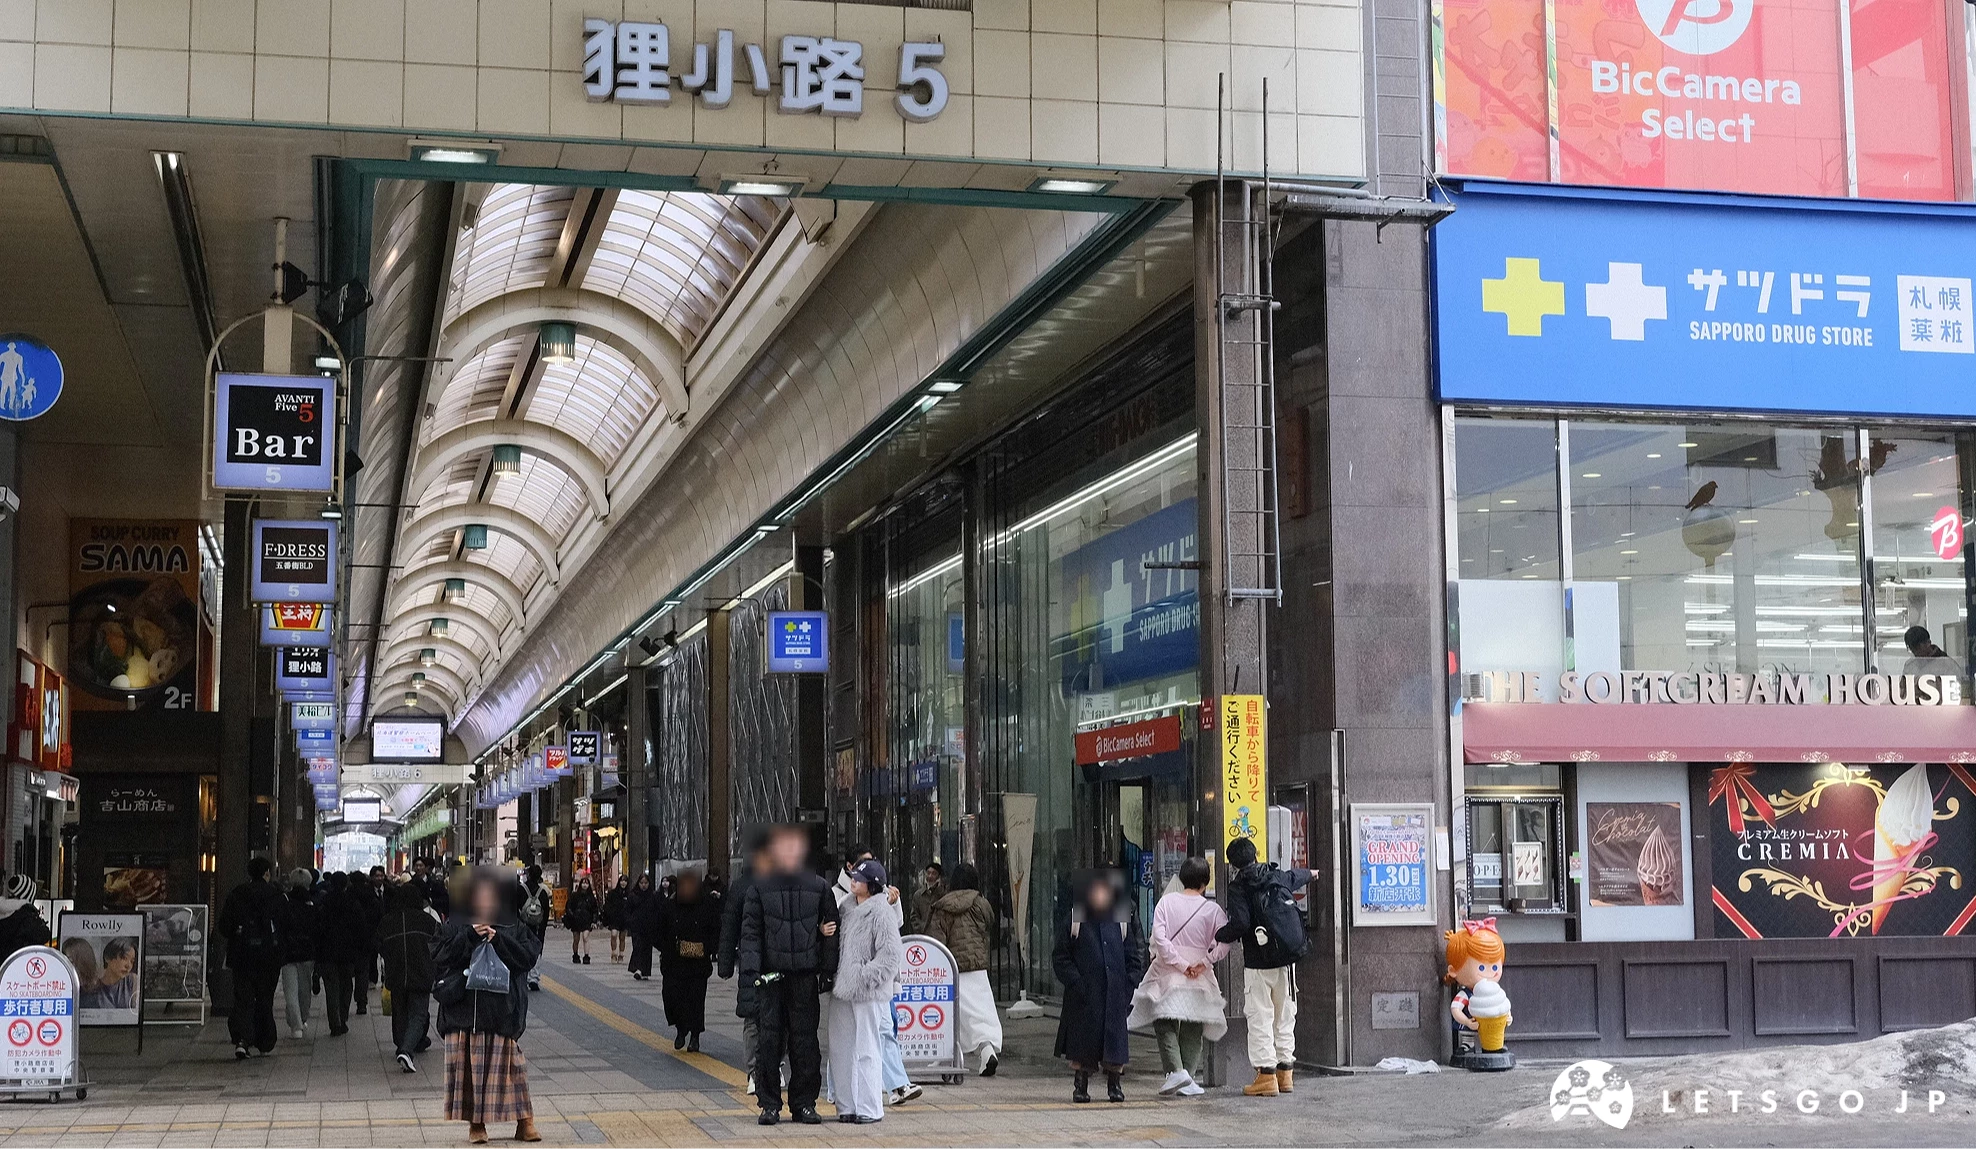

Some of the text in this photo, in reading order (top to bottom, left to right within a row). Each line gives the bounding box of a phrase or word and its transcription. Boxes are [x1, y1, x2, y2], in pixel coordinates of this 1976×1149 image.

[583, 18, 948, 122] 狸小路 5
[1591, 60, 1801, 105] BicCamera
[1641, 108, 1755, 143] Select
[1687, 268, 1871, 318] サツドラ
[1909, 286, 1962, 312] 札幌
[1690, 321, 1873, 347] SAPPORO DRUG STORE
[274, 394, 315, 404] AVANTI
[275, 402, 314, 423] Five 5
[234, 428, 314, 459] Bar
[265, 467, 282, 484] 5
[80, 543, 190, 574] SAMA
[288, 584, 300, 598] 5
[282, 604, 314, 621] 王将
[1140, 610, 1170, 642] SAPPORO
[1172, 604, 1191, 634] DRUG
[289, 660, 322, 673] 狸小路
[794, 659, 803, 670] 5
[300, 678, 309, 688] 5
[1559, 671, 1812, 706] SOFTCREAM
[1826, 674, 1962, 706] HOUSE
[164, 686, 192, 709] 2F
[1103, 729, 1155, 753] BicCamera Select
[1226, 701, 1241, 804] ご通行ください
[1245, 700, 1261, 803] 自転車から降りて
[110, 789, 158, 798] らーめん
[99, 799, 167, 813] 吉山商店
[1368, 841, 1419, 853] GRAND
[1737, 843, 1850, 861] CREMIA
[1368, 853, 1420, 864] OPENING
[1369, 866, 1410, 886] 1.30
[82, 919, 123, 933] Rowlly
[901, 968, 947, 977] ートボード禁止
[6, 981, 66, 991] スケートボード禁止
[896, 986, 949, 1001] 行者専用
[4, 999, 67, 1015] 歩行者専用
[7, 1049, 62, 1058] 防犯カメラ作動中
